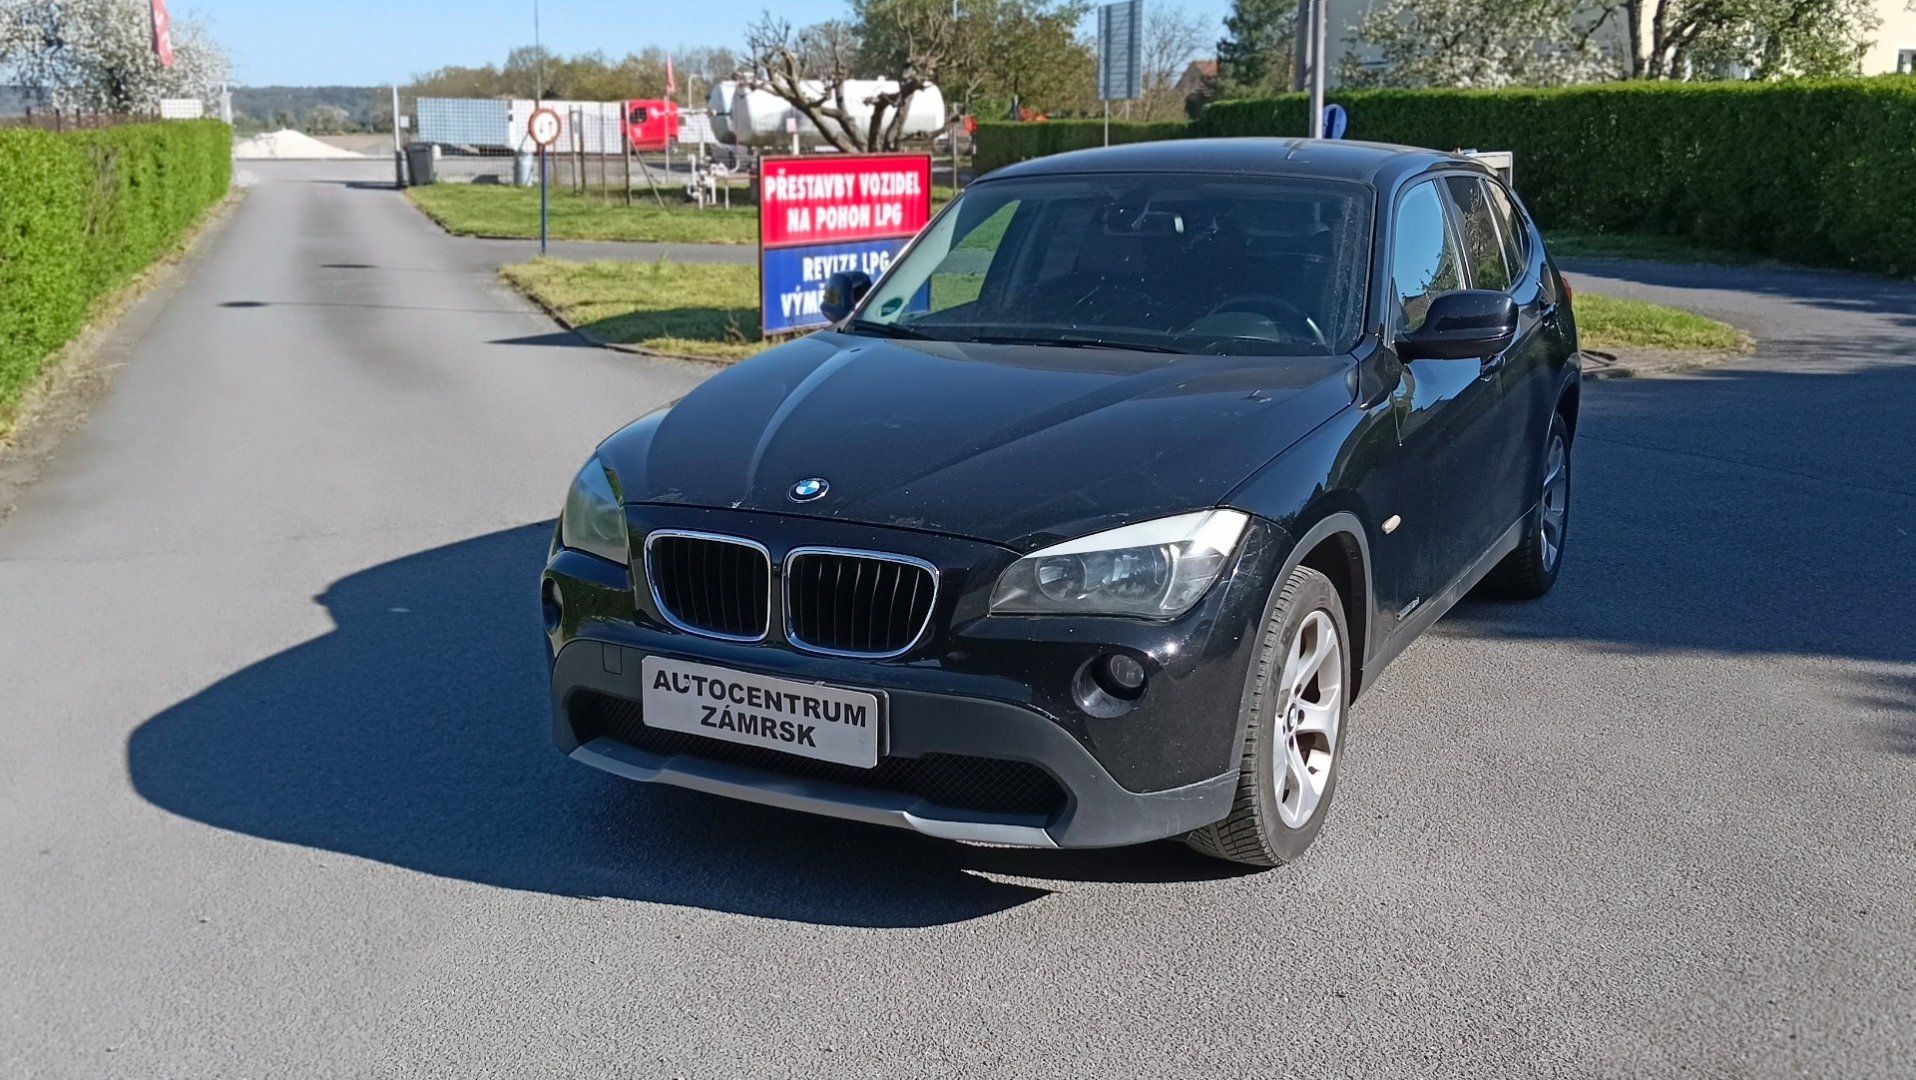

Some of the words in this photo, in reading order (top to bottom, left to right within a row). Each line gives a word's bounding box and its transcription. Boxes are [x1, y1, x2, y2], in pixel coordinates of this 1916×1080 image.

[764, 167, 855, 201] PŘESTAVBY
[859, 171, 921, 198] VOZIDEL
[787, 207, 811, 232] NA
[816, 204, 872, 231] POHON
[875, 202, 903, 226] LPG
[803, 252, 857, 282] REVIZE
[862, 250, 890, 275] LPG
[781, 283, 826, 317] VÝMĚ
[652, 669, 867, 728] AUTOCENTRUM
[700, 704, 817, 748] ZÁMRSK
